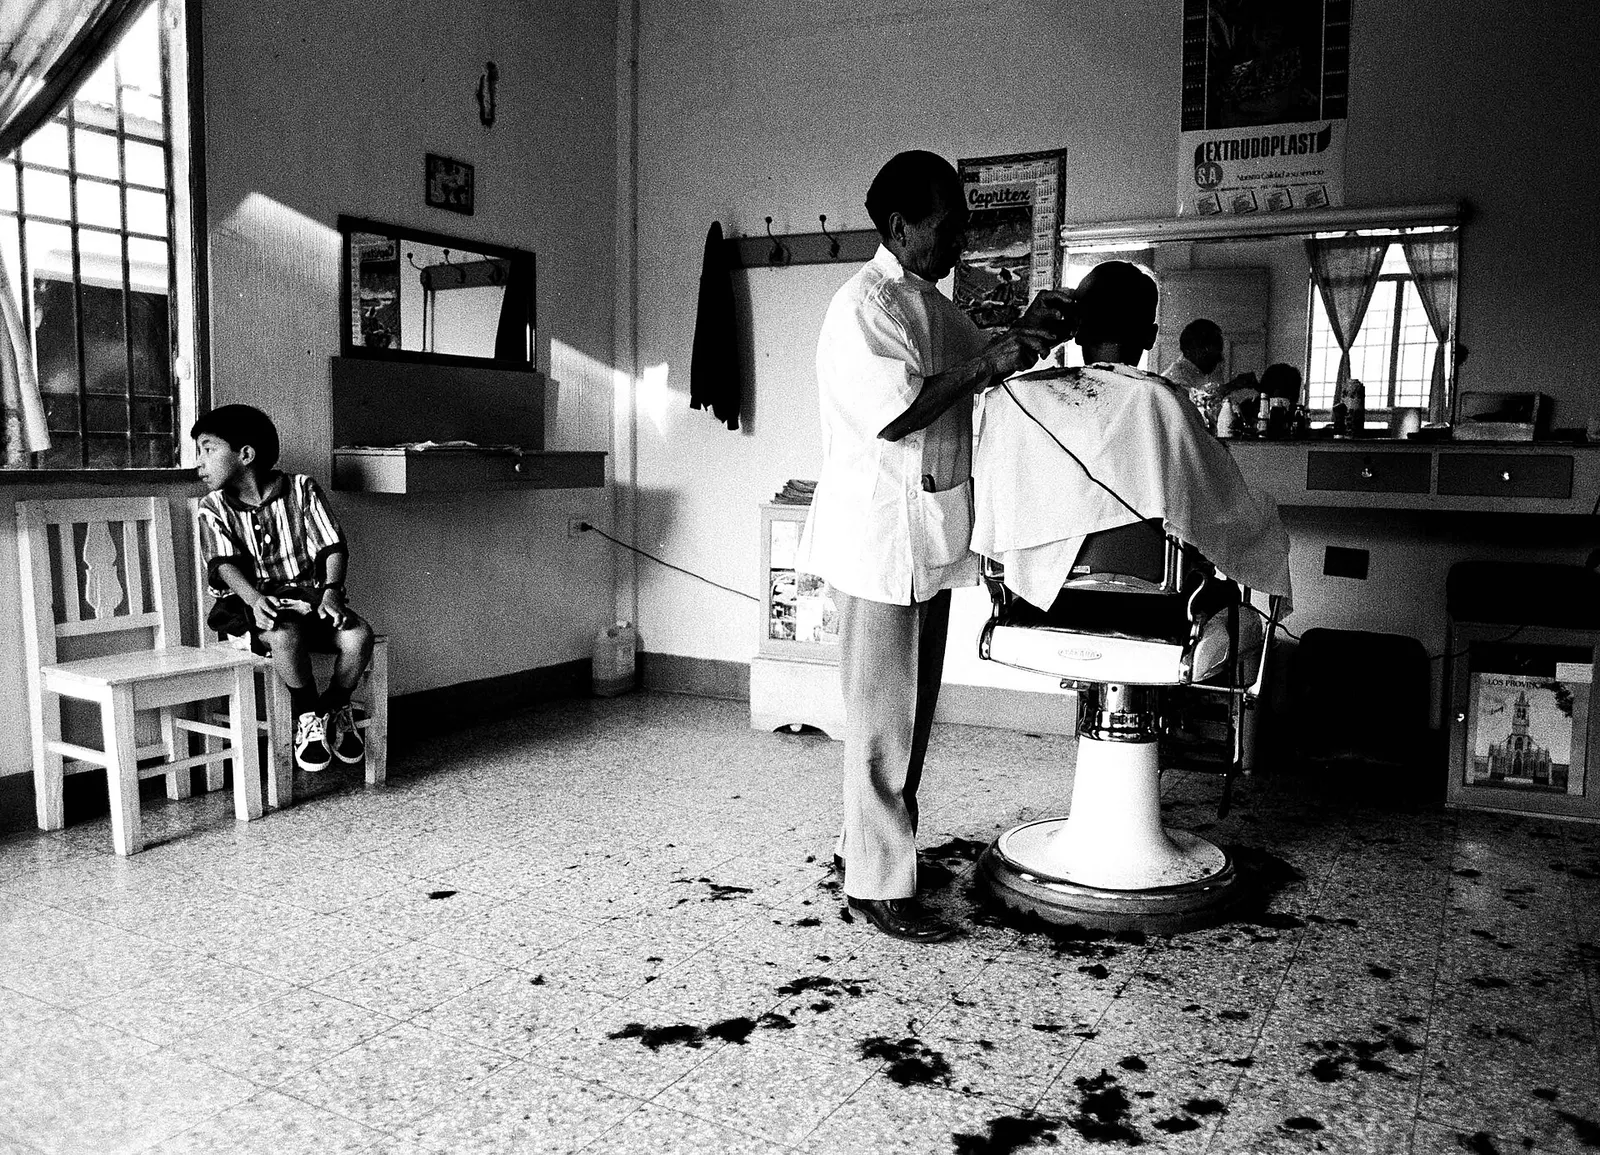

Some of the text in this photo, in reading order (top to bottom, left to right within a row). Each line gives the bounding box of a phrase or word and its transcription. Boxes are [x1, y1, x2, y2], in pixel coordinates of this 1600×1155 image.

[1205, 133, 1317, 162] EXTRUDOPLAST
[968, 188, 1031, 208] Capritex
[1488, 679, 1503, 687] LOS
